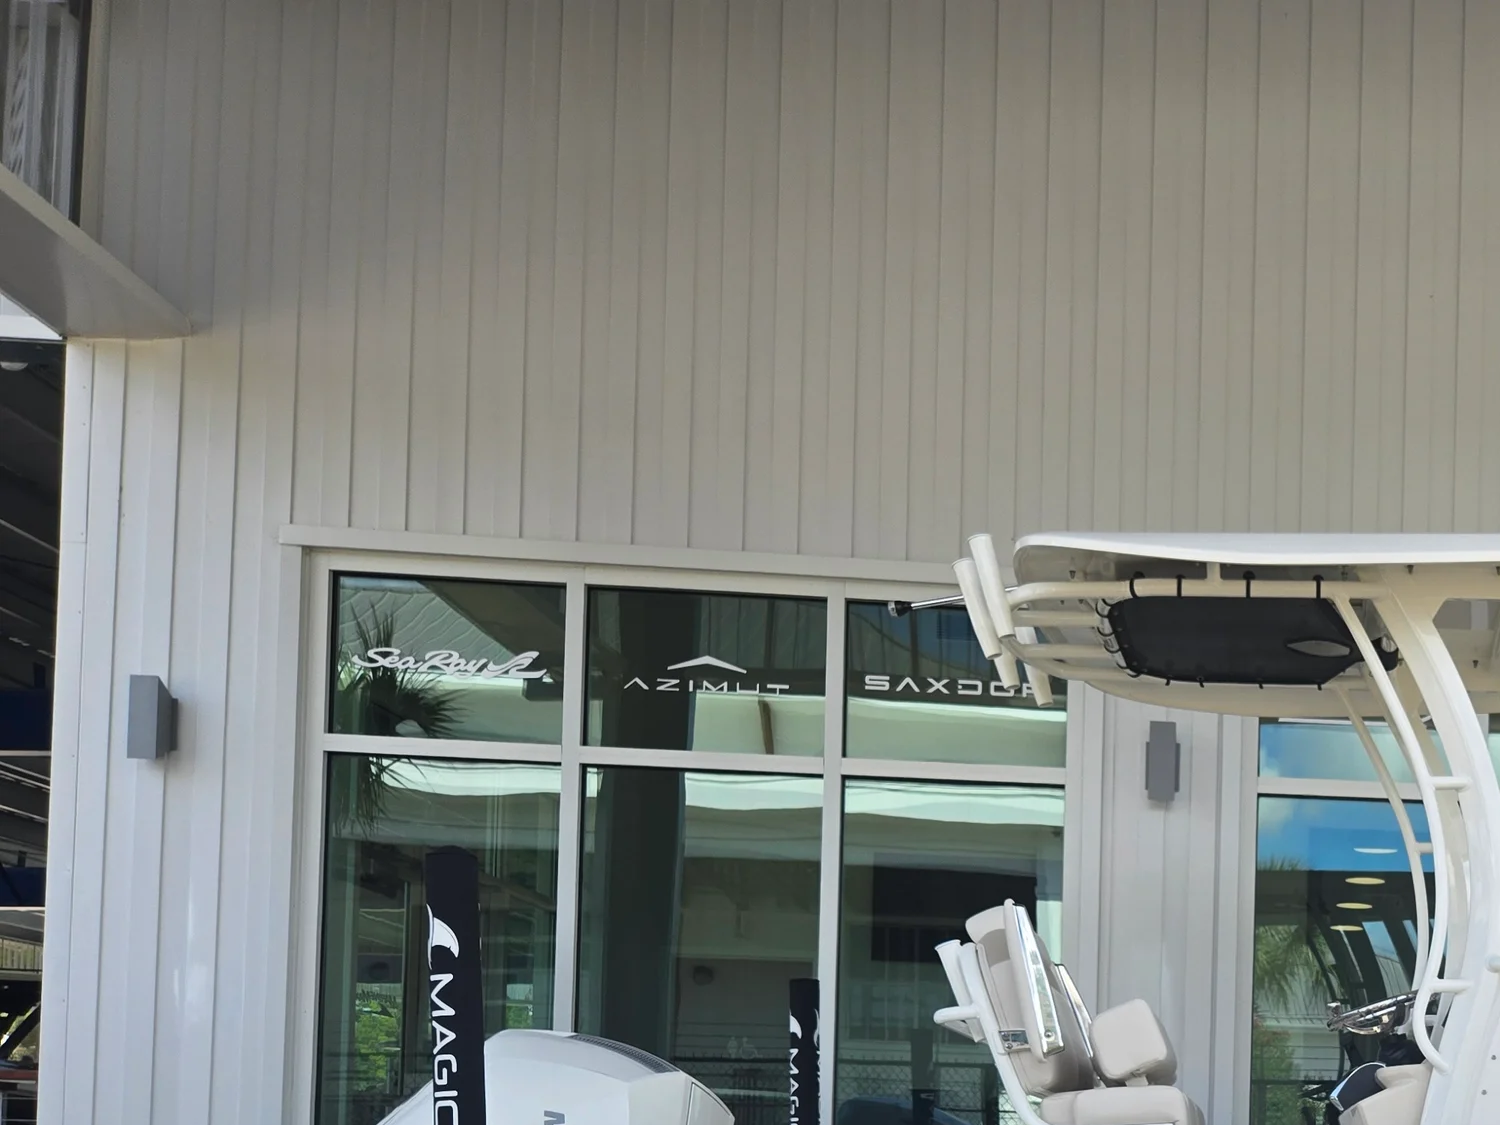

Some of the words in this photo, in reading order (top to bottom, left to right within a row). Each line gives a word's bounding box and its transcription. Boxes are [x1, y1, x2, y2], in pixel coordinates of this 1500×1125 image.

[352, 647, 423, 669] Sea
[419, 650, 489, 679] Ray
[623, 676, 791, 697] AZIMUT
